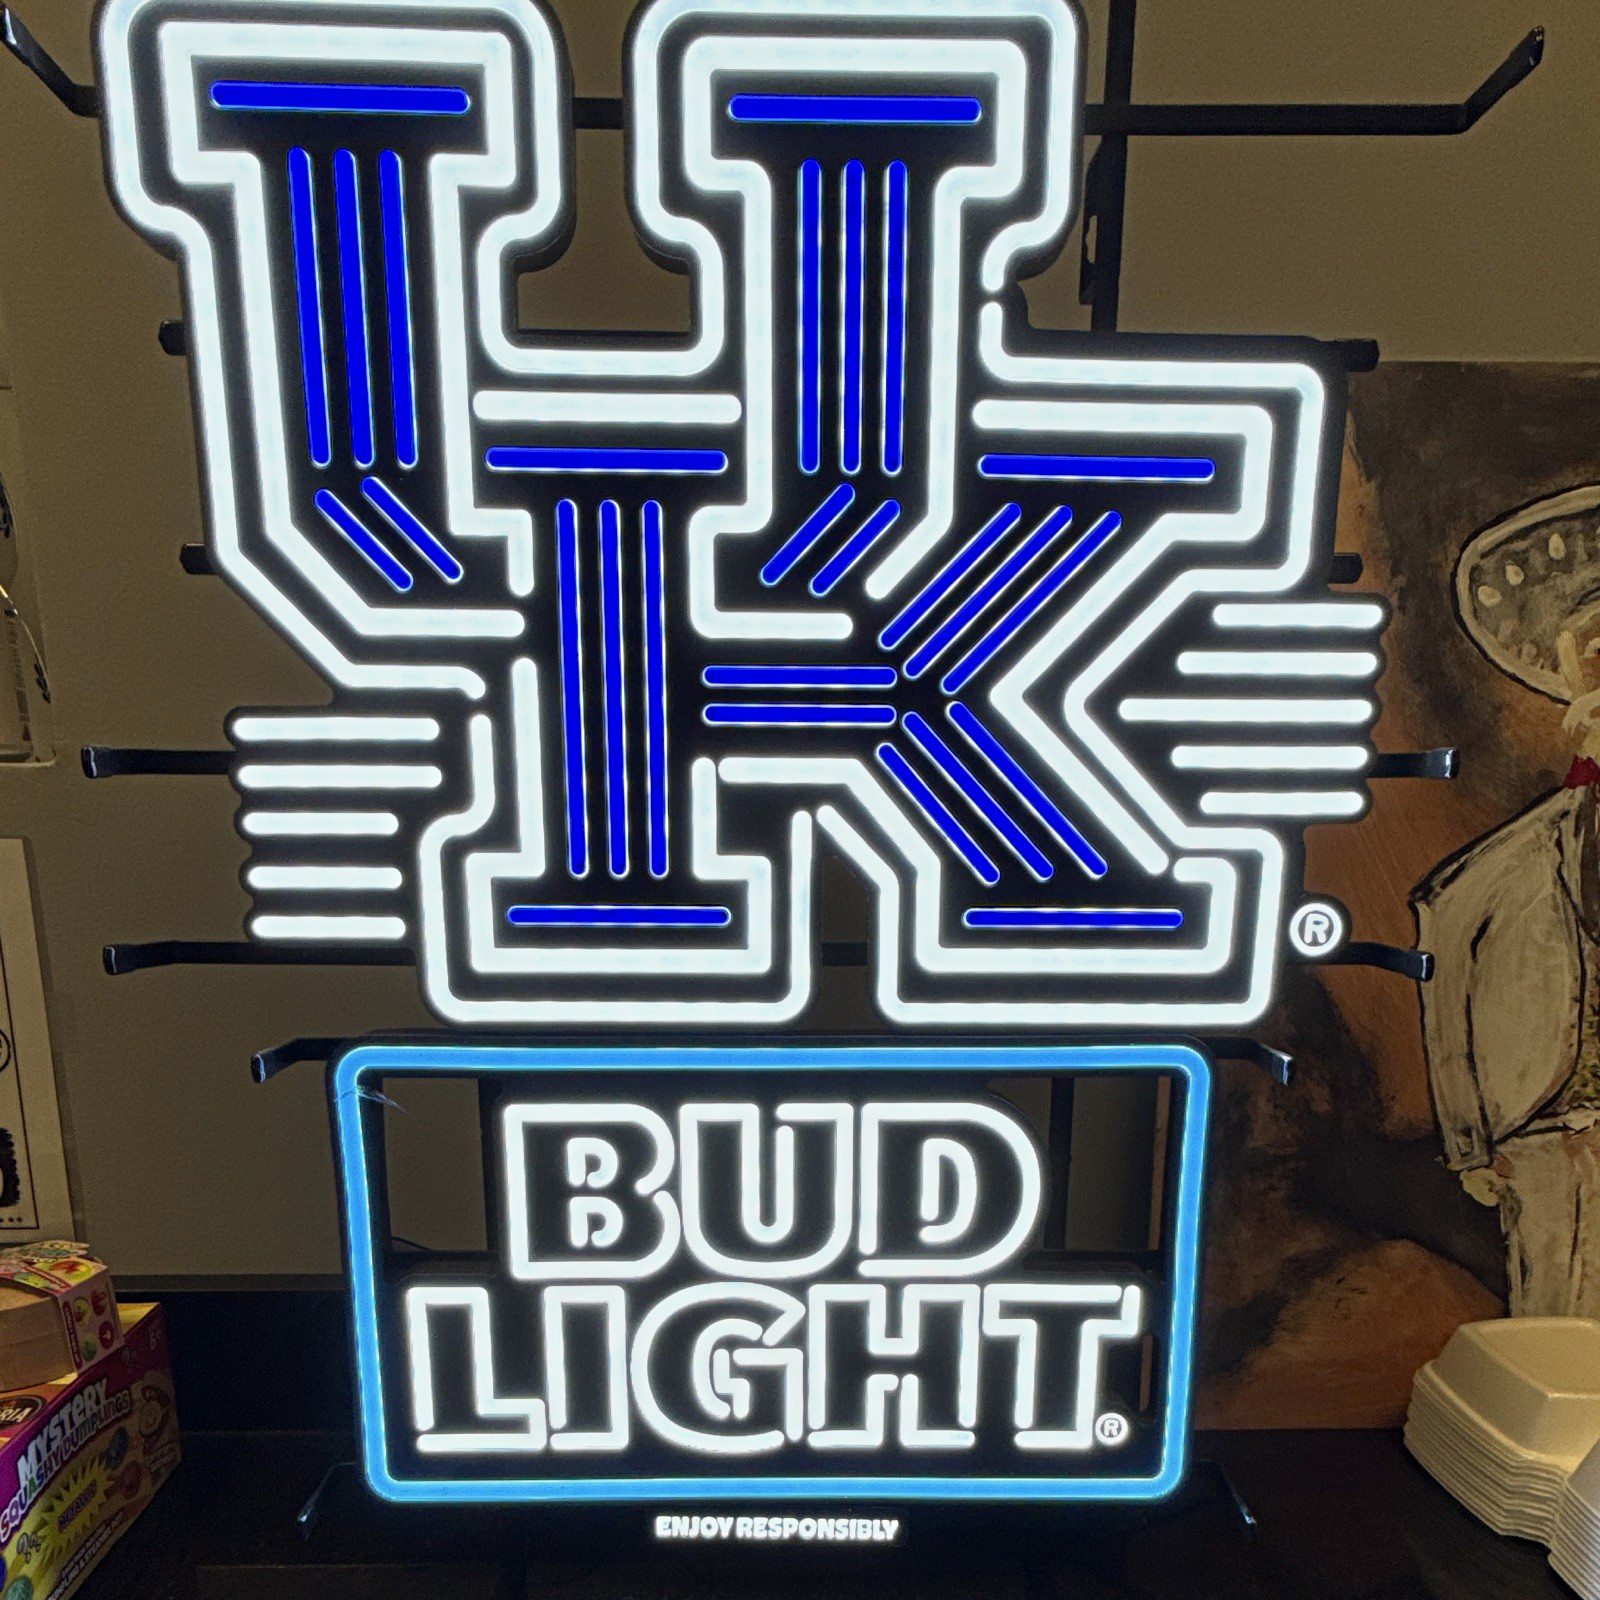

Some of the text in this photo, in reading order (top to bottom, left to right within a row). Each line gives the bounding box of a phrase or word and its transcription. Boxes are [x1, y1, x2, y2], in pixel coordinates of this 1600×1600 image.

[502, 1100, 1043, 1281] BUD
[405, 1279, 1142, 1454] LIGHT
[654, 1514, 900, 1542] ENJOY RESPONSIBLY
